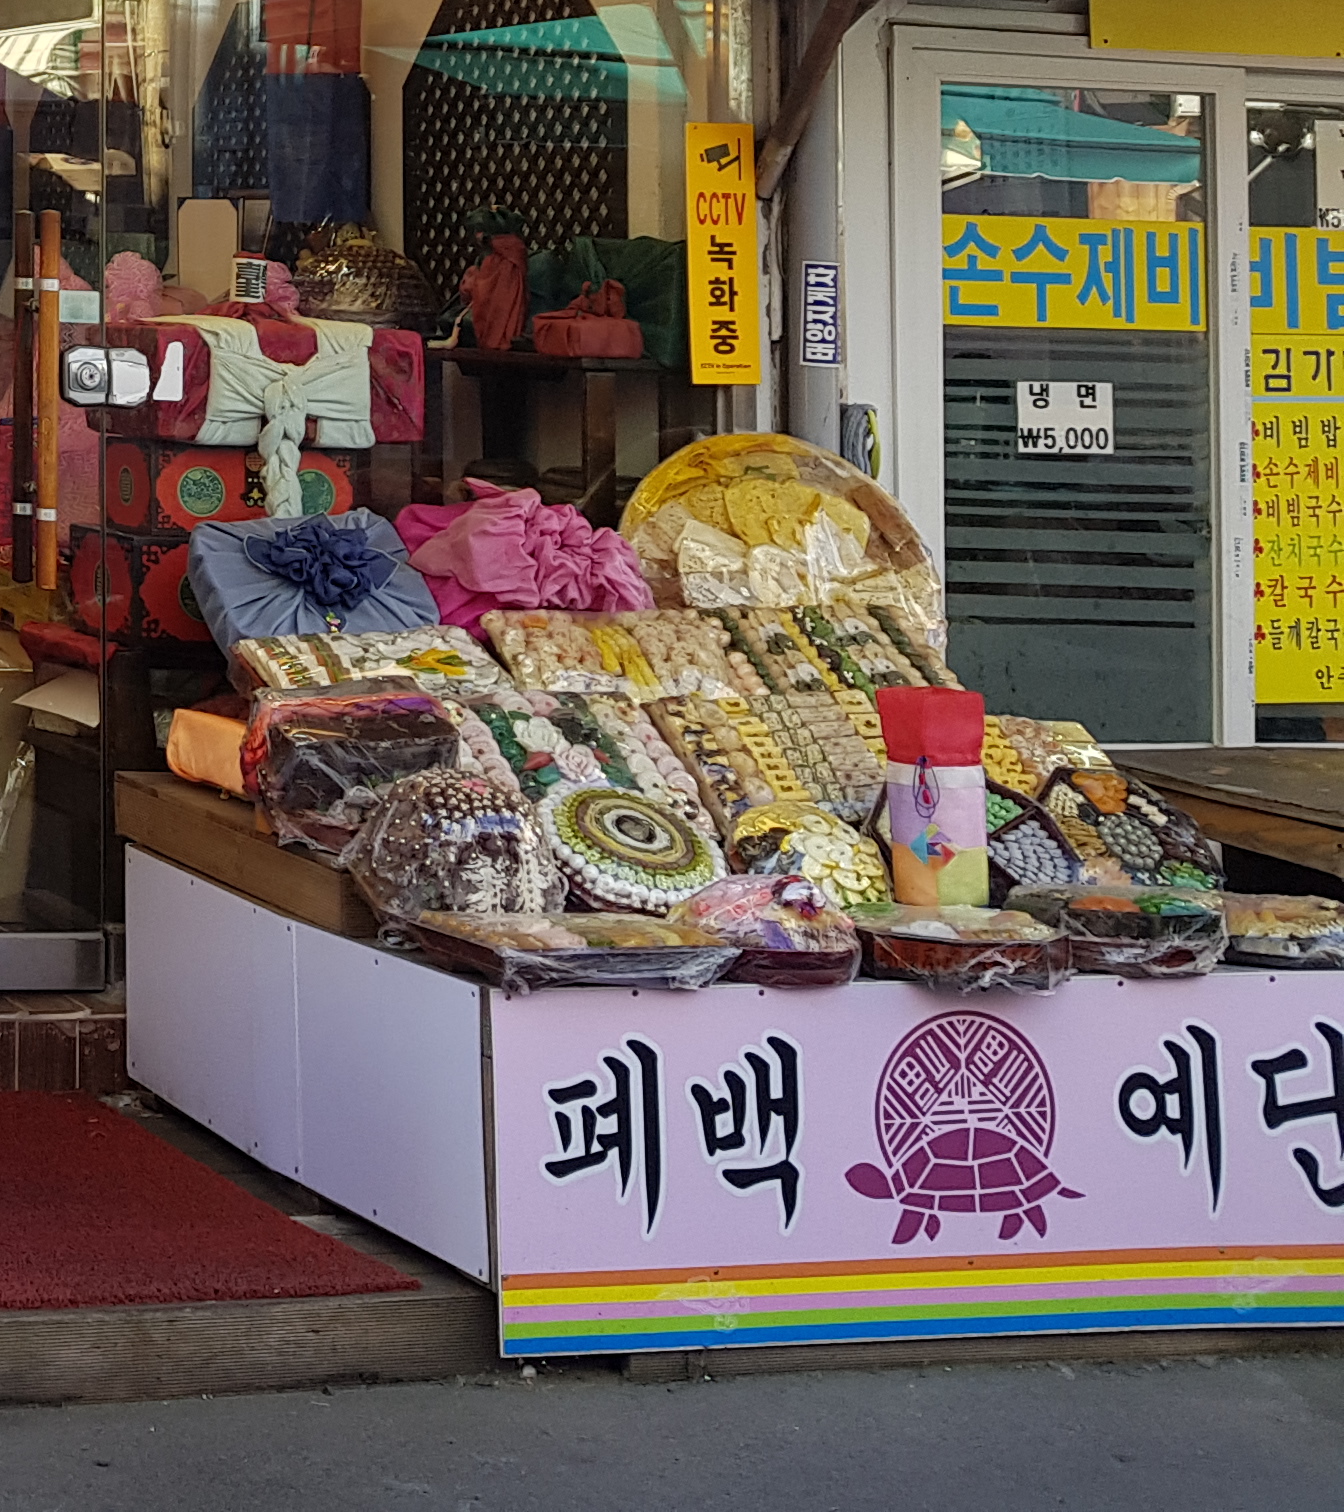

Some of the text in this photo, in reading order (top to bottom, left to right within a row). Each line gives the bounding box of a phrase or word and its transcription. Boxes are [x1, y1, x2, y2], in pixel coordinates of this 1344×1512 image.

[696, 192, 747, 226] CCTV
[942, 221, 1201, 326] 손수제비
[707, 235, 739, 355] 녹화중
[804, 266, 837, 362] 태양지게차
[1018, 426, 1110, 454] ₩5,000
[1262, 456, 1340, 489] 손수제비
[1265, 493, 1344, 529] 비빔국수
[1266, 574, 1344, 609] 칼국수
